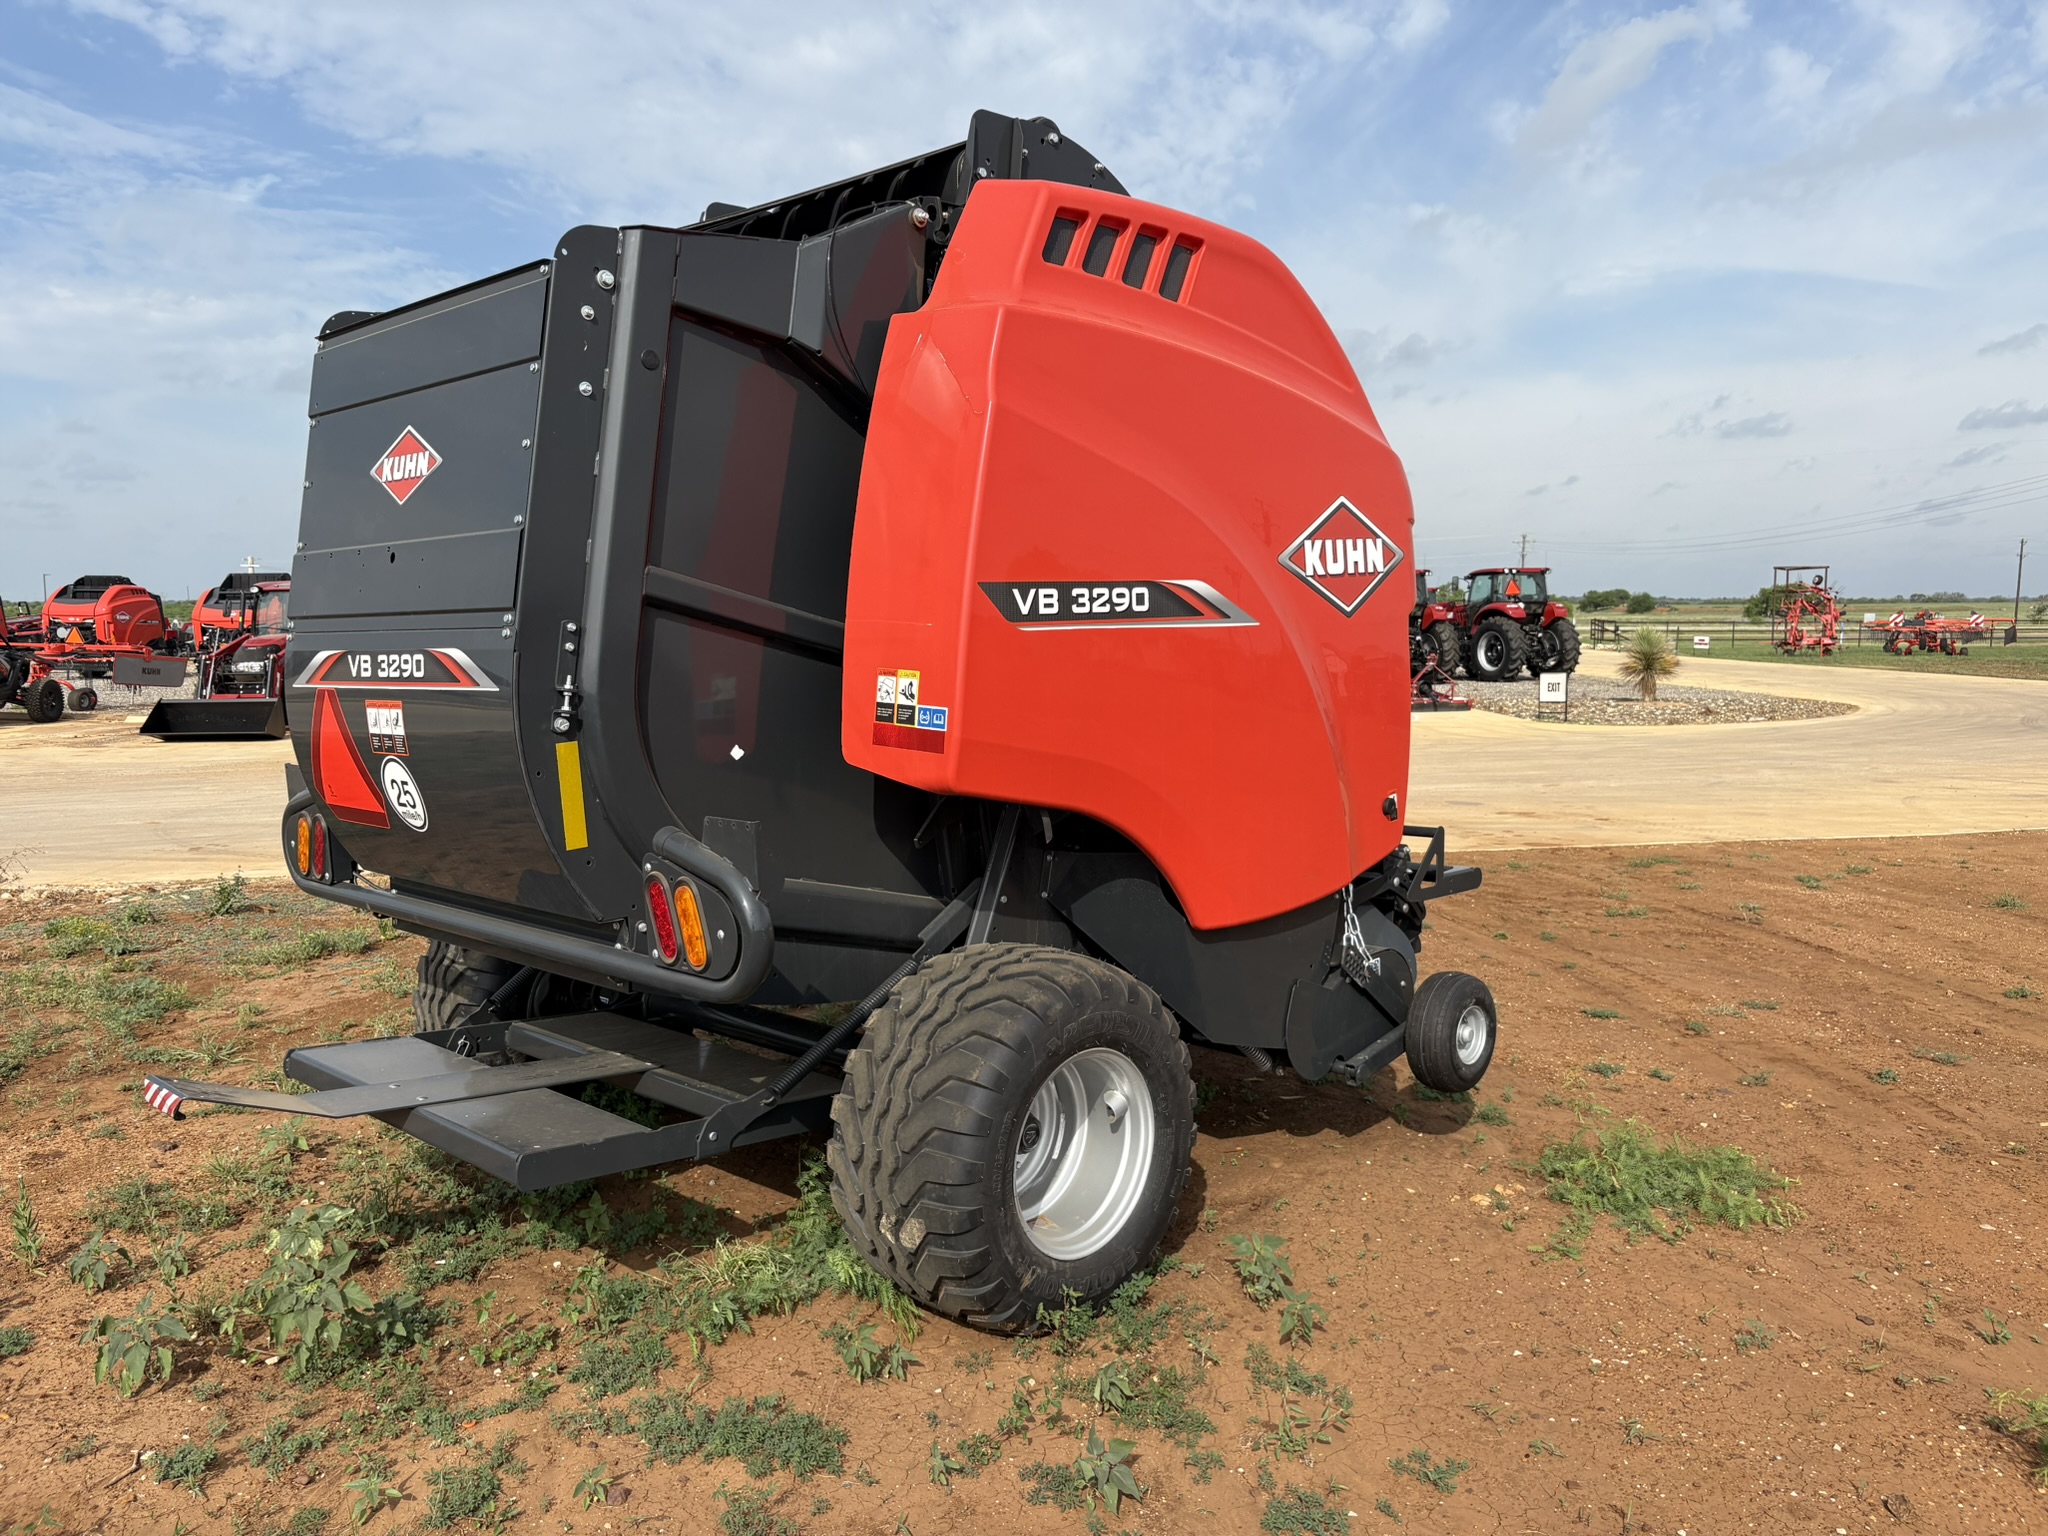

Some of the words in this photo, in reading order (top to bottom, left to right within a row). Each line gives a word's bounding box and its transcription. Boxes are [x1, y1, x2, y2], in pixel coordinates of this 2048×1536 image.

[381, 450, 430, 483] KUHN
[1303, 538, 1385, 577] KUHN
[1012, 587, 1060, 615] VB
[1071, 586, 1150, 614] 3290
[142, 667, 161, 675] KUHN
[347, 654, 372, 678] VB
[377, 653, 425, 678] 3290
[1547, 682, 1561, 692] EXIT
[390, 778, 417, 810] 25
